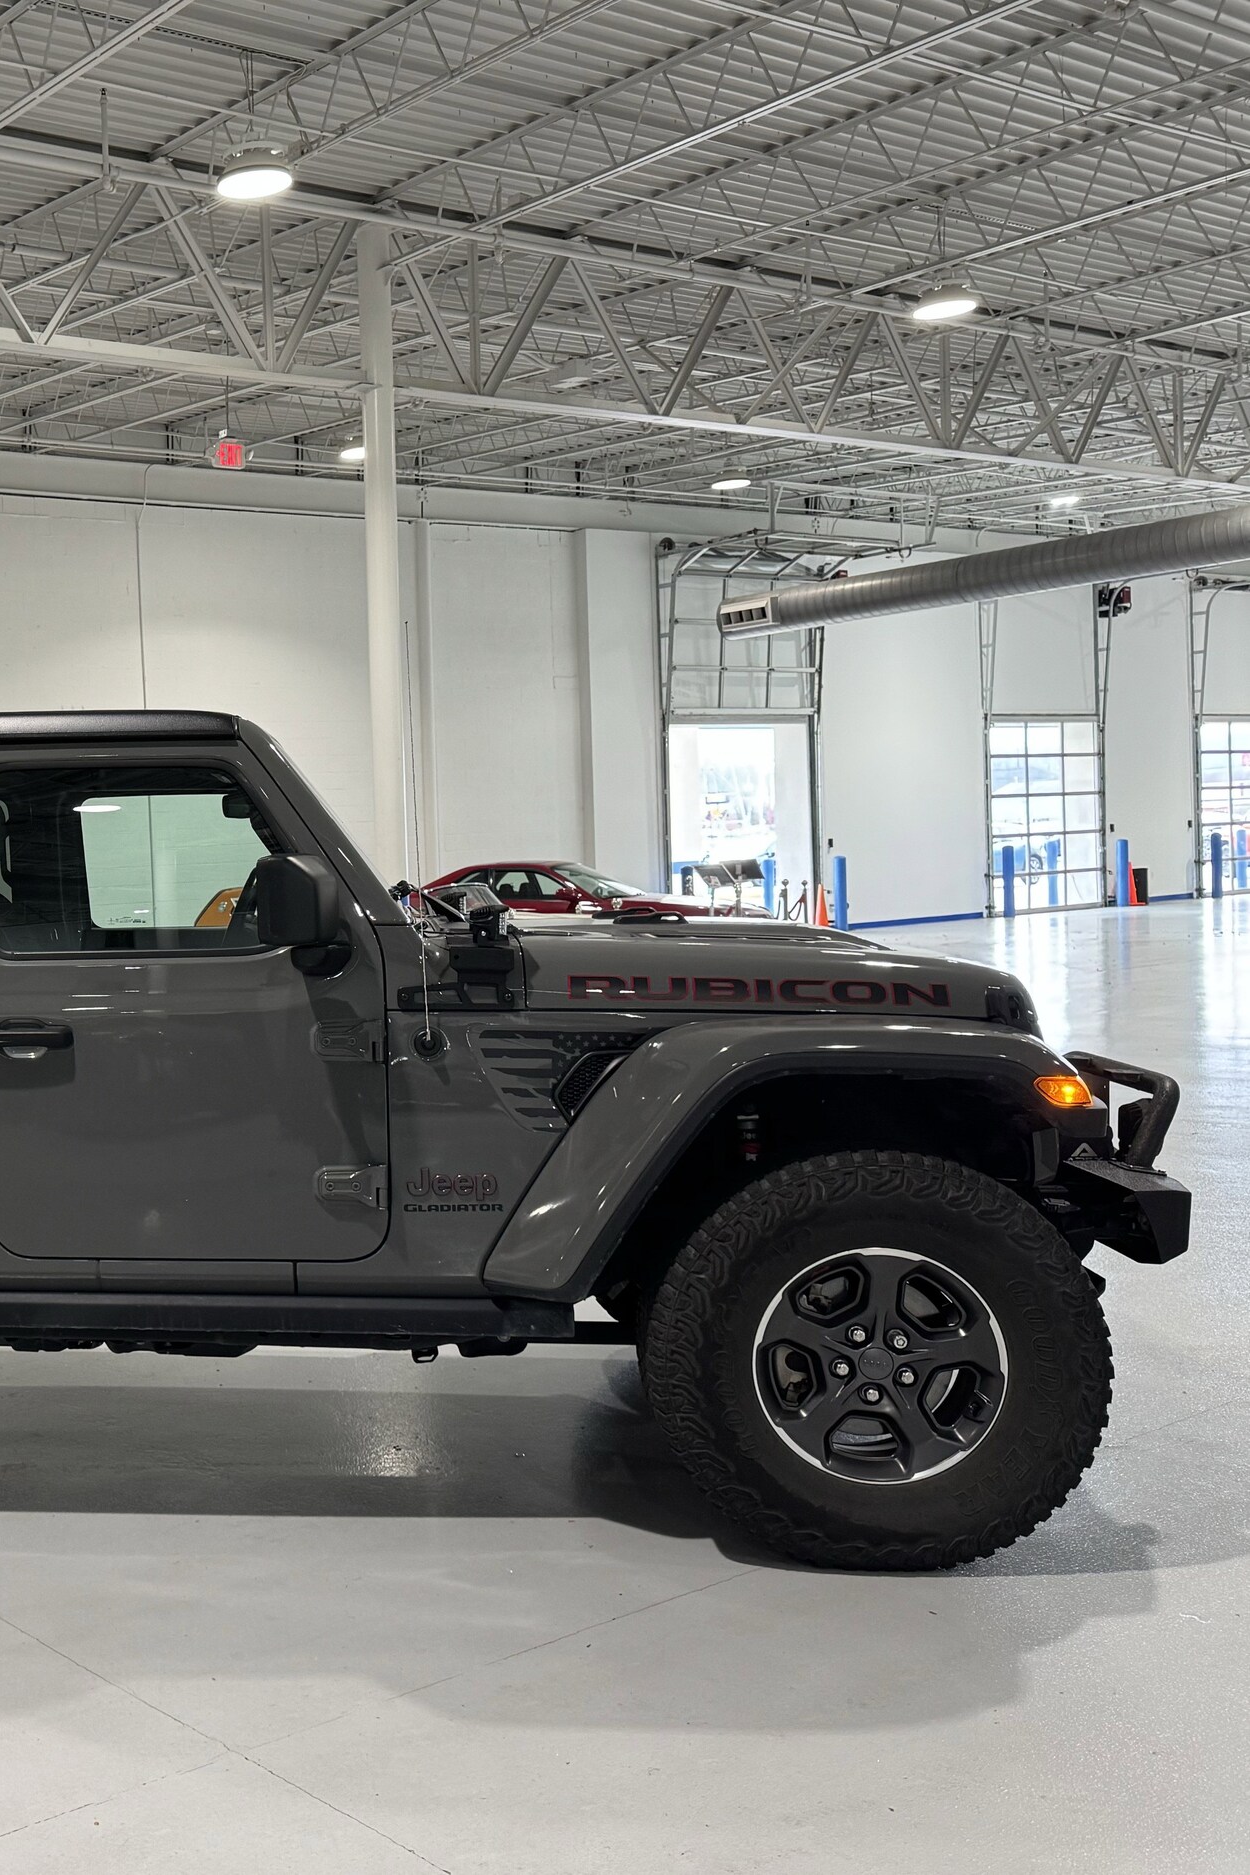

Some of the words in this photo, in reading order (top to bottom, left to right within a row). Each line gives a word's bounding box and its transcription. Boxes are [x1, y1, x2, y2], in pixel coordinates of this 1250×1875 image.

[567, 975, 951, 1008] RUBICON
[405, 1167, 498, 1201] Jeep
[403, 1204, 503, 1212] GLADIATOR
